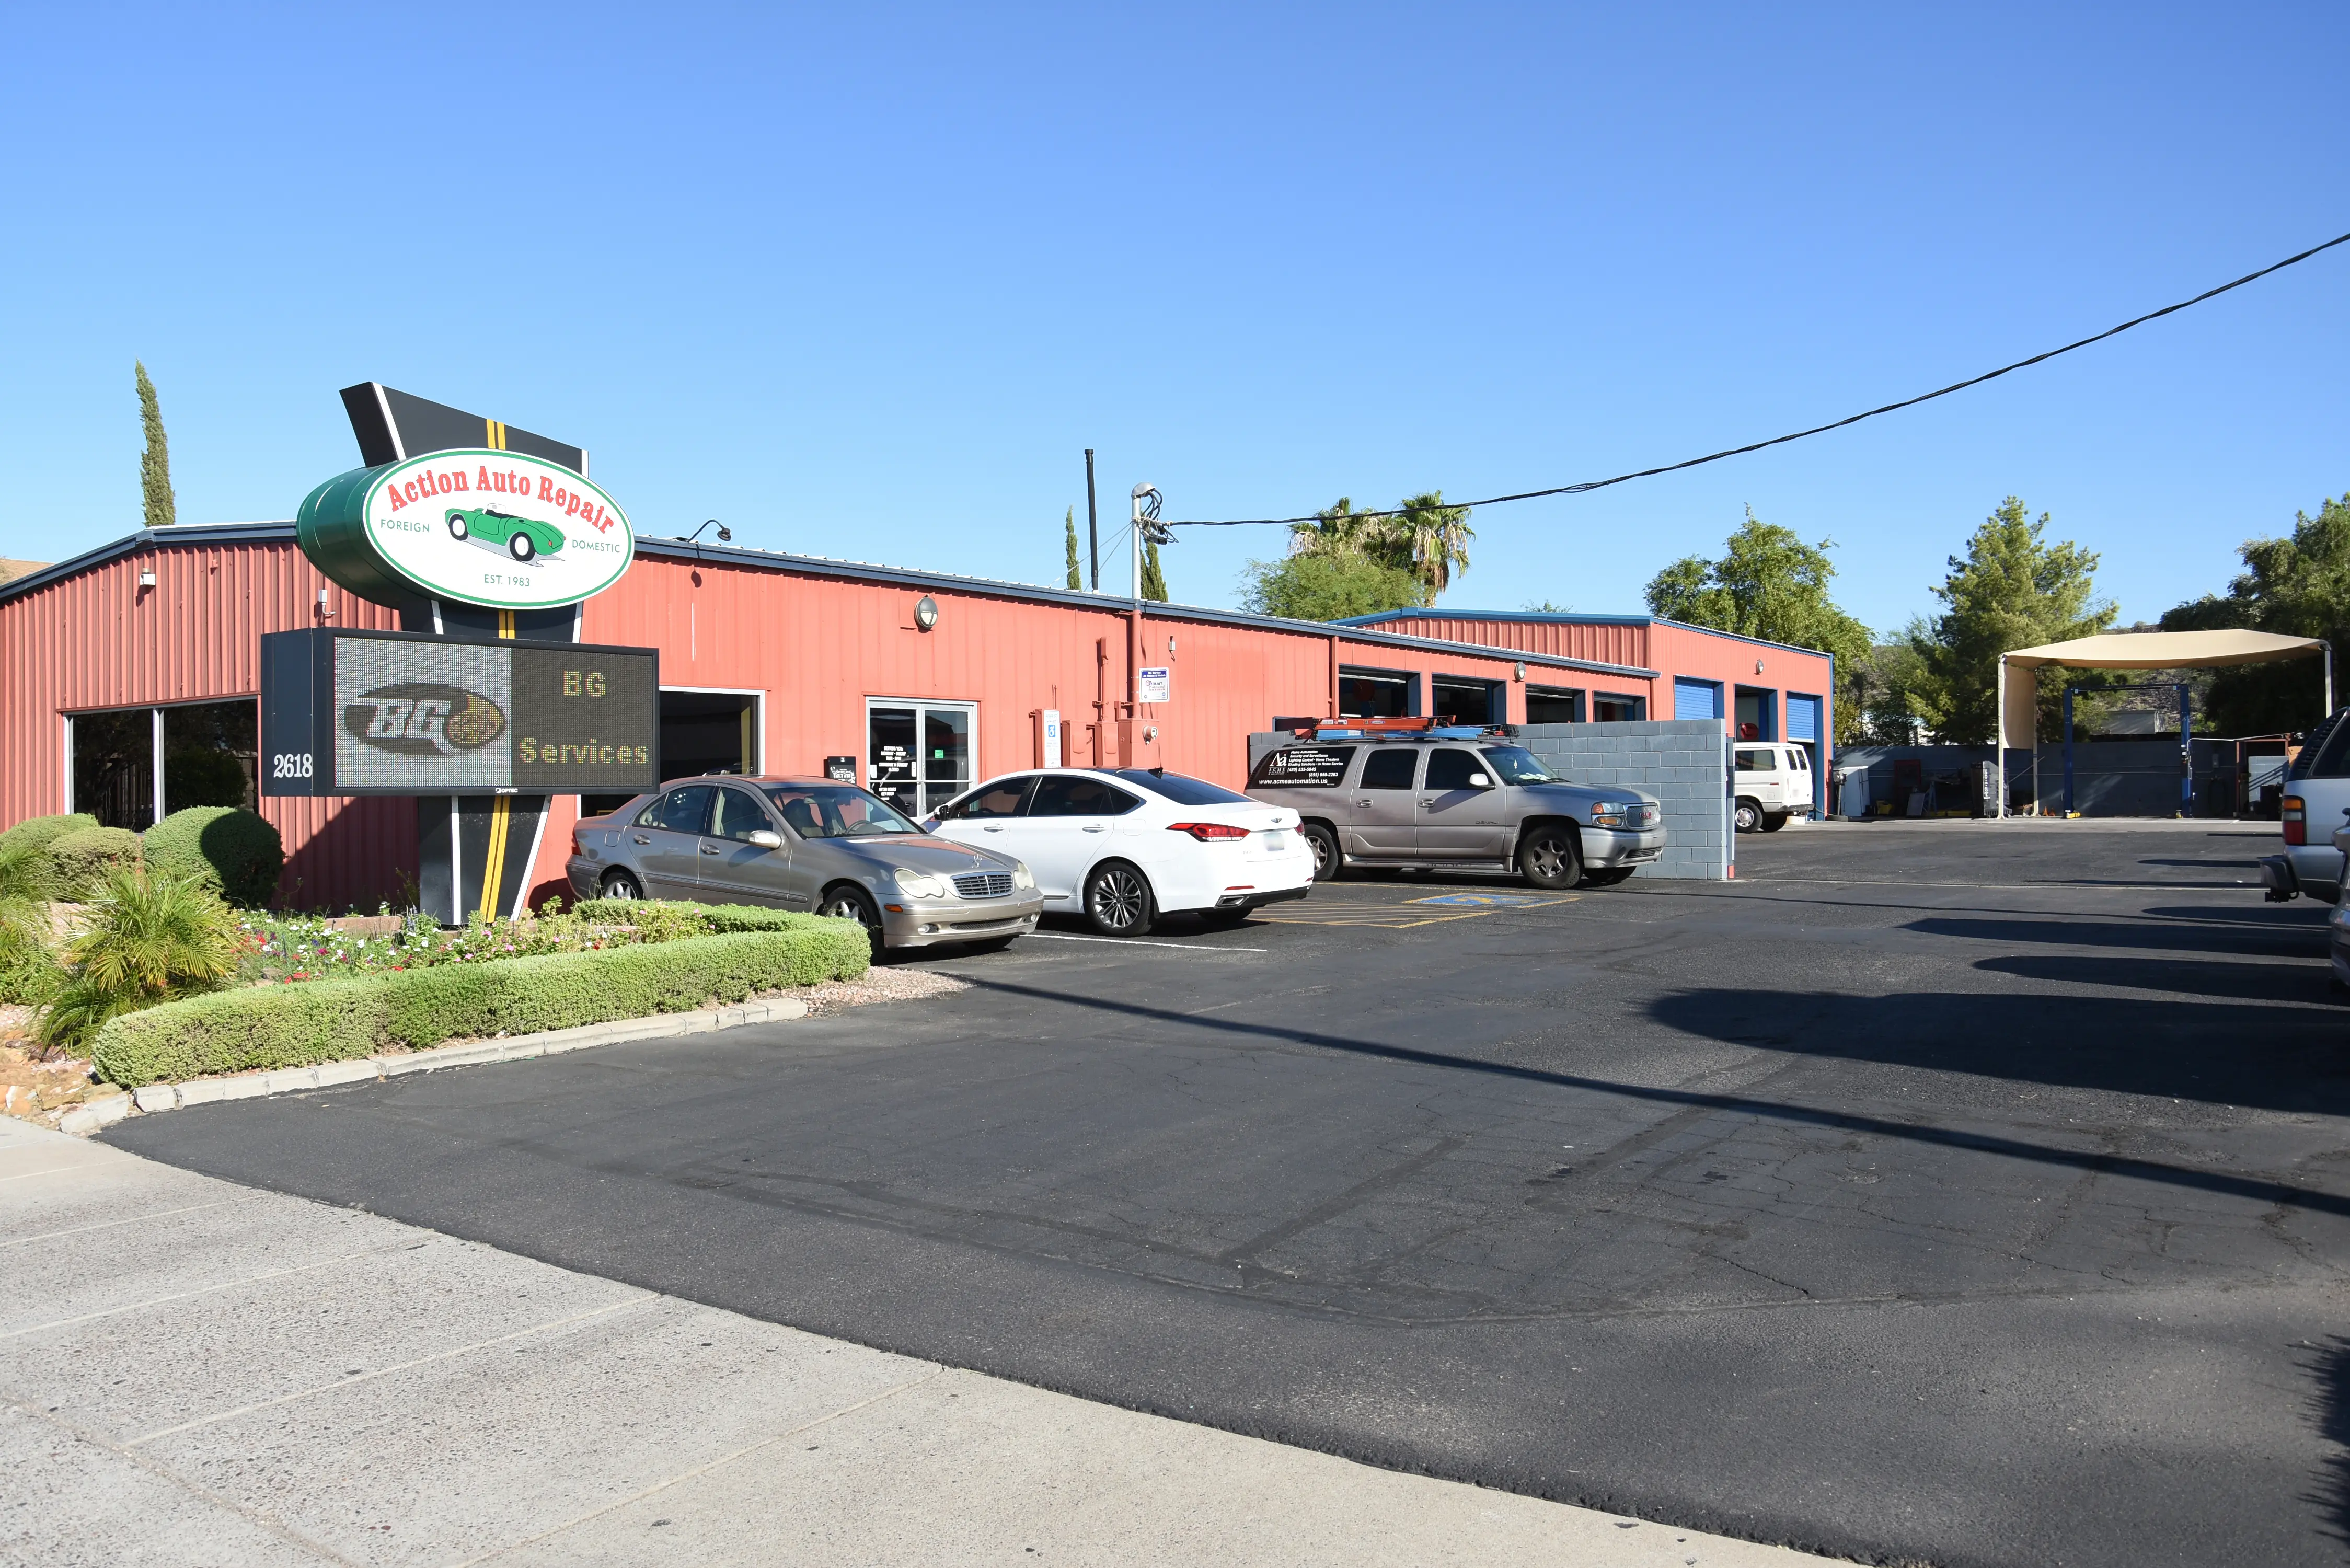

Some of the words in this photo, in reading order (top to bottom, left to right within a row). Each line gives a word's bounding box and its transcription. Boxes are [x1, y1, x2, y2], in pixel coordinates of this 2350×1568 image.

[387, 469, 469, 512] Action
[476, 466, 530, 496] Auto
[537, 475, 614, 534] Repair
[380, 518, 430, 533] FOREIGN
[572, 539, 621, 553] DOMESTIC
[484, 574, 503, 585] EST.
[507, 575, 531, 587] 1983
[562, 671, 605, 697] BG
[365, 699, 452, 741] BG
[519, 737, 648, 763] Services
[273, 753, 313, 778] 2618
